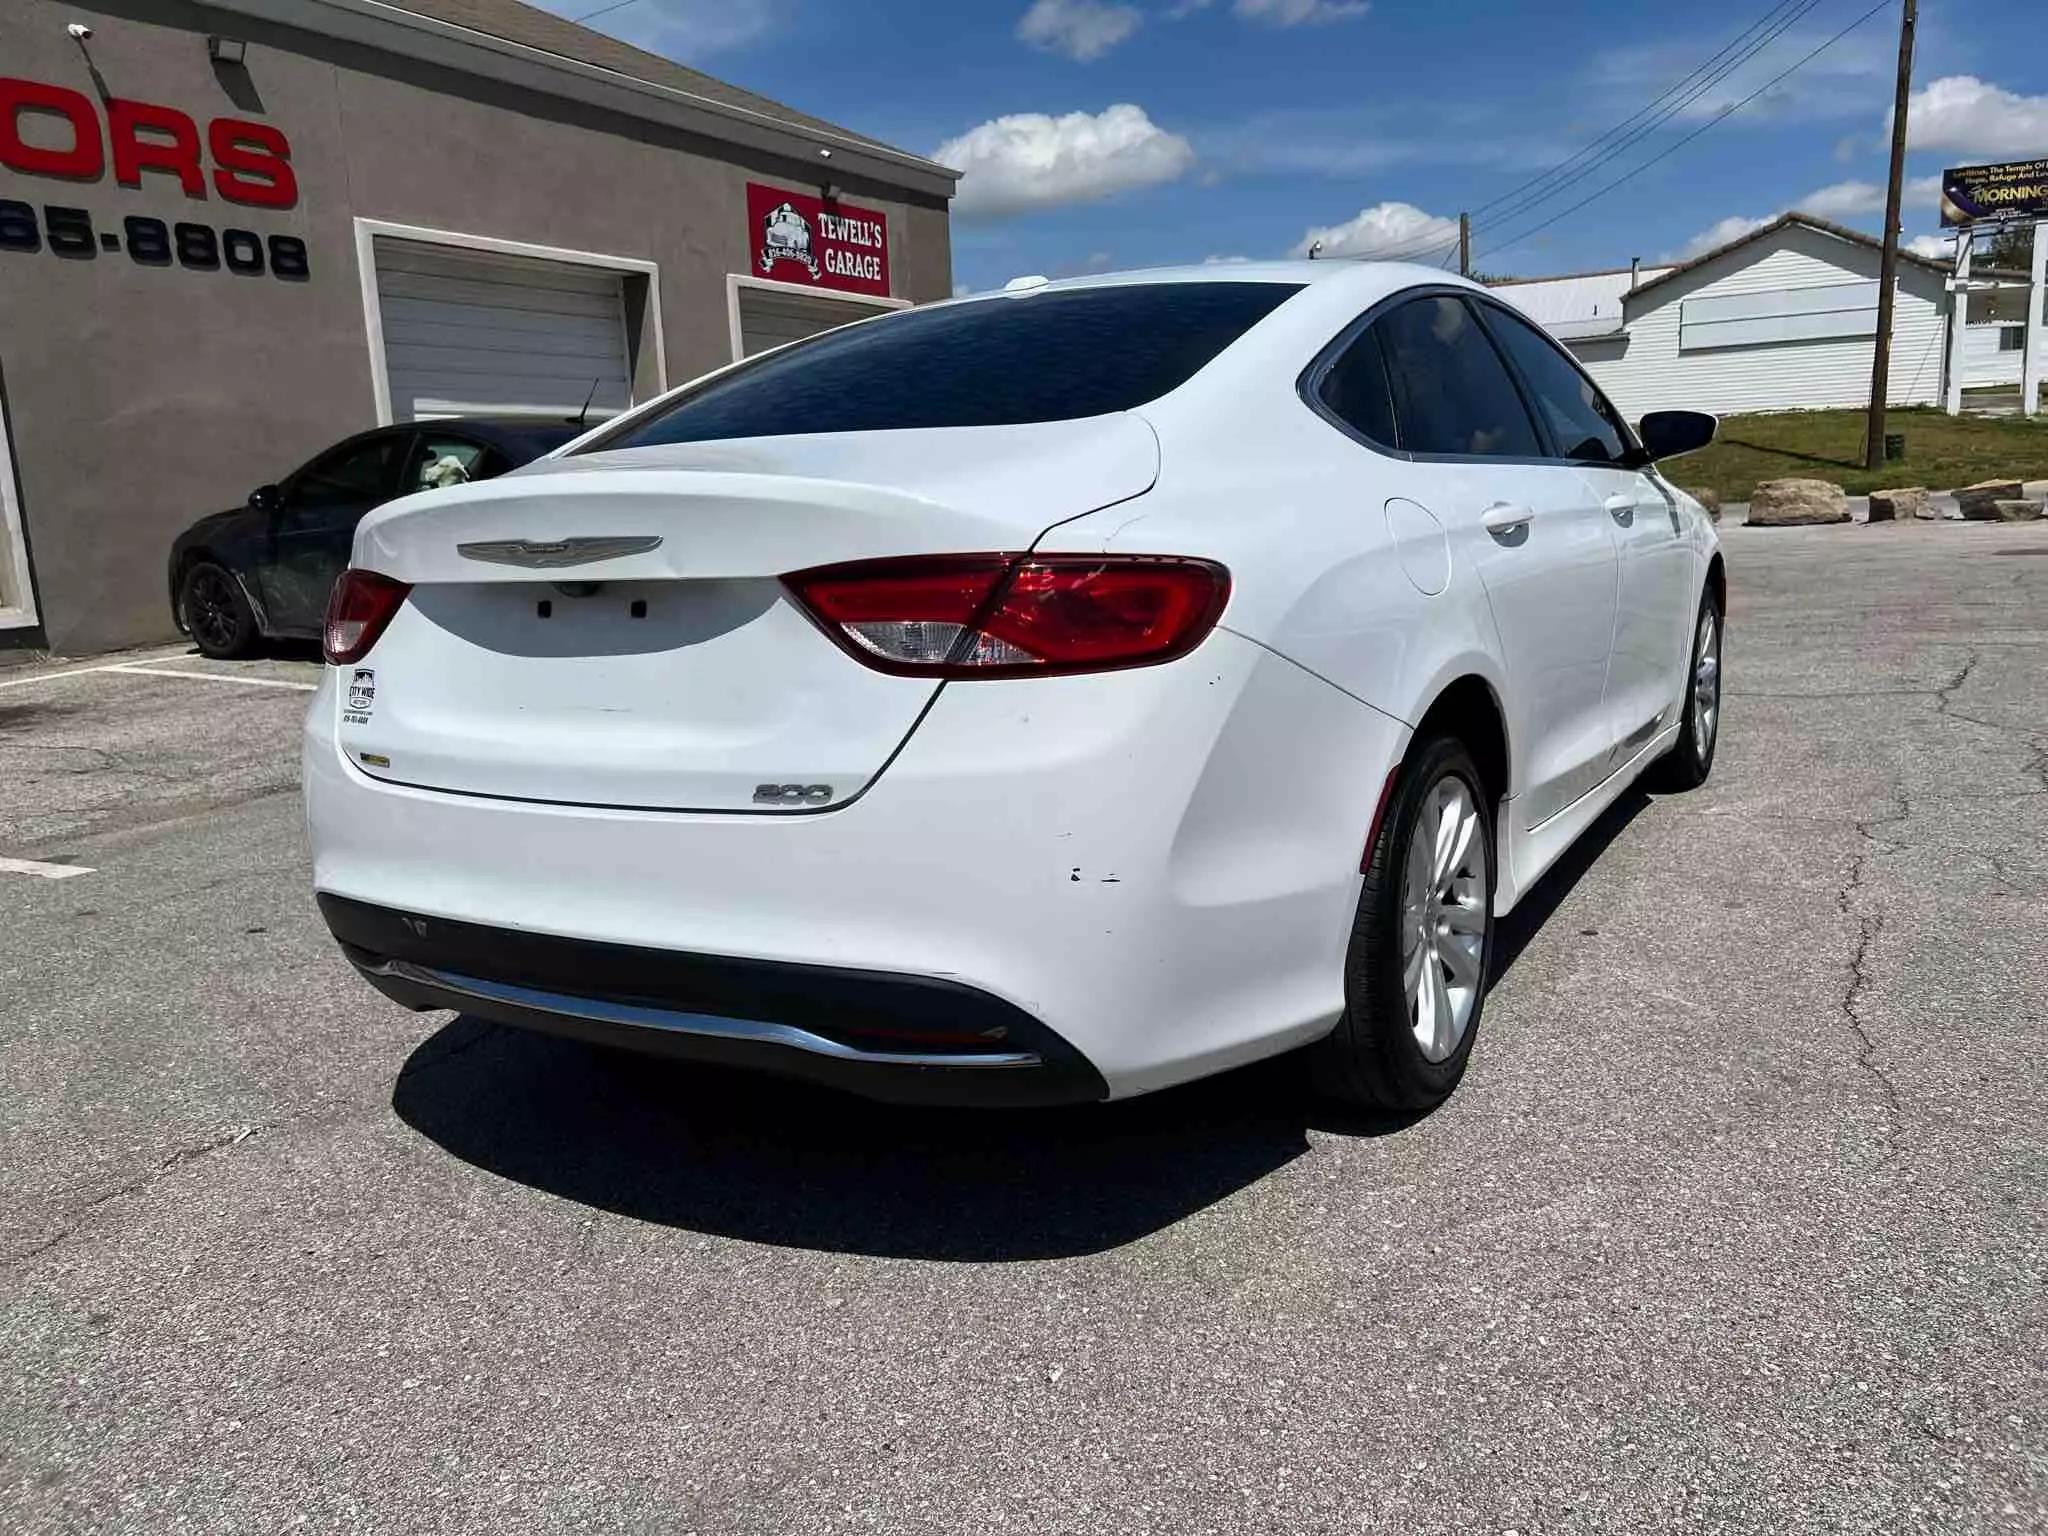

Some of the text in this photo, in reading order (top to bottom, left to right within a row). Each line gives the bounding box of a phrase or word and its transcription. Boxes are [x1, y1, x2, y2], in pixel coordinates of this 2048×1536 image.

[0, 78, 298, 208] ORS
[1974, 185, 2048, 204] MORNING
[817, 213, 882, 249] TEWELL'S
[825, 249, 881, 281] GARAGE
[752, 784, 833, 805] 200
